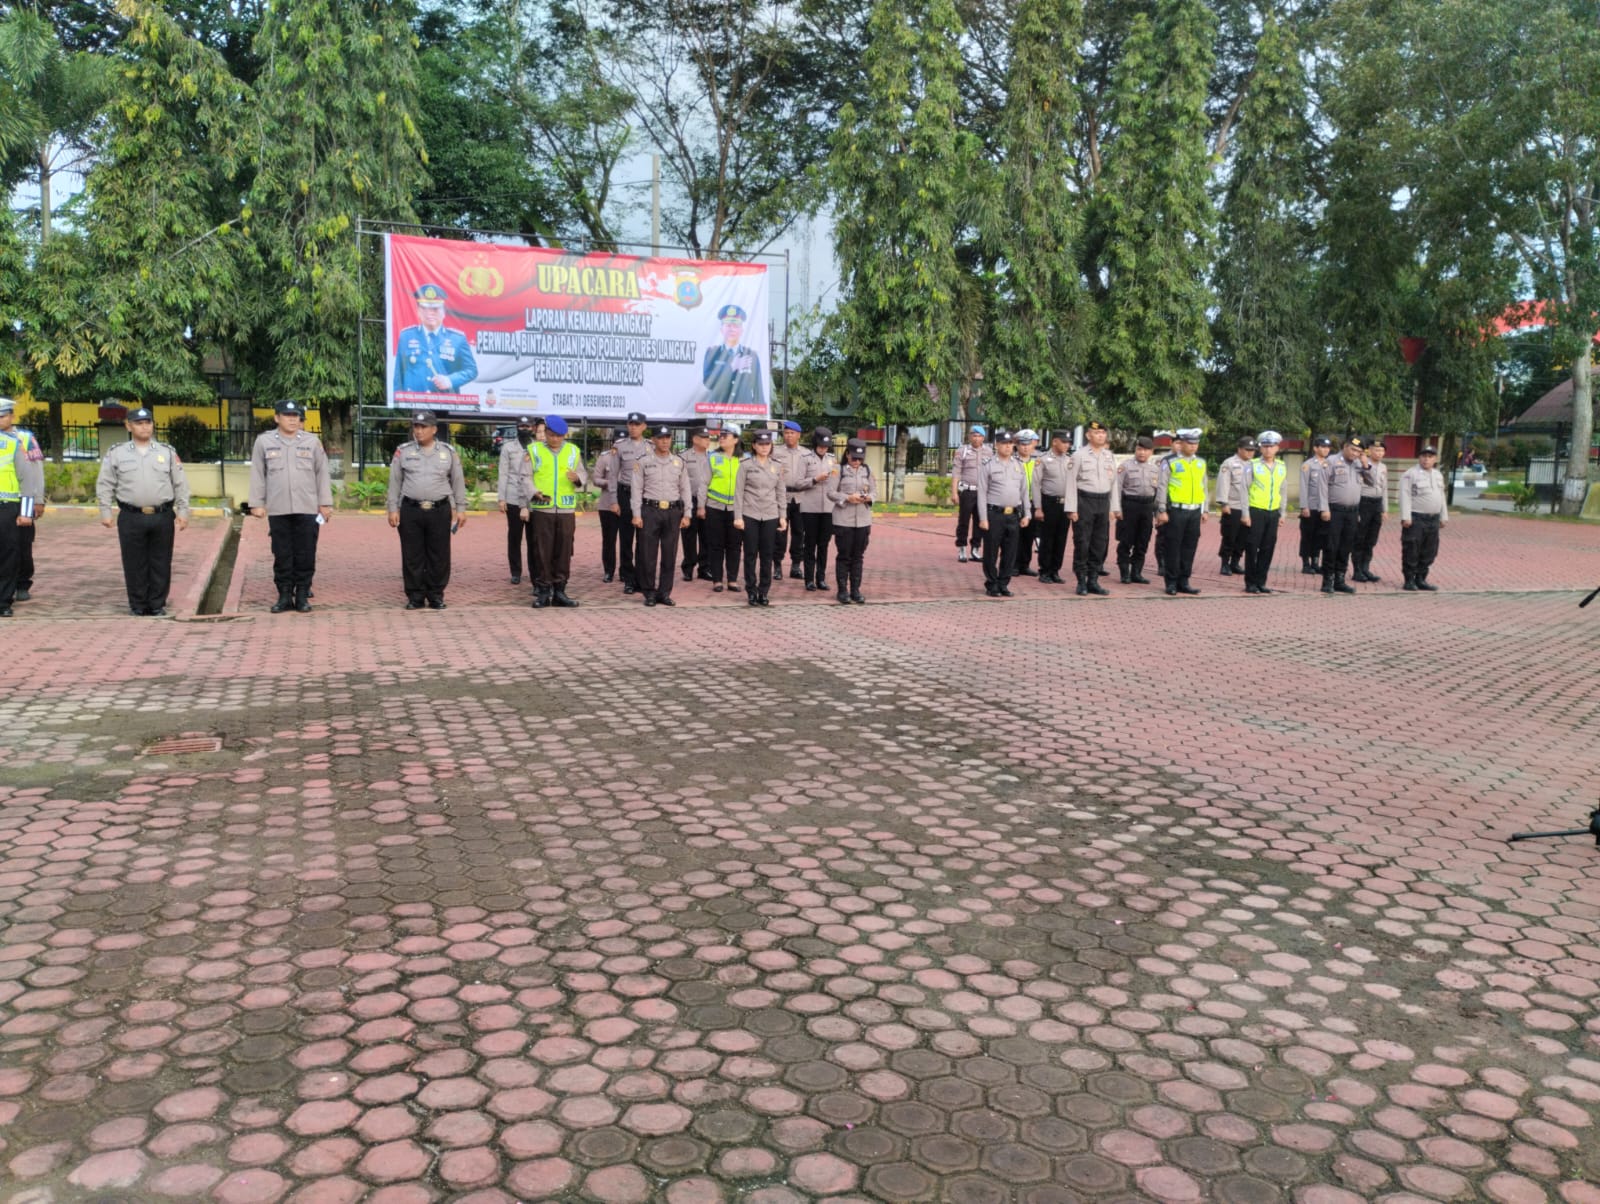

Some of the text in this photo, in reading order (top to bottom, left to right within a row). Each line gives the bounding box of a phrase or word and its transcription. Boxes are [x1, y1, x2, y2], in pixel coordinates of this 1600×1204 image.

[536, 264, 641, 298] UPACARA
[525, 307, 652, 337] LAPORAN KENAIKAN PANGKAT
[476, 330, 696, 364] PERWIRA, BINTARA DAN PNS POLRI POLRES LANGKAT
[534, 358, 643, 386] PERIODE 01 JANUARI 2024
[583, 394, 611, 408] DESEMBER
